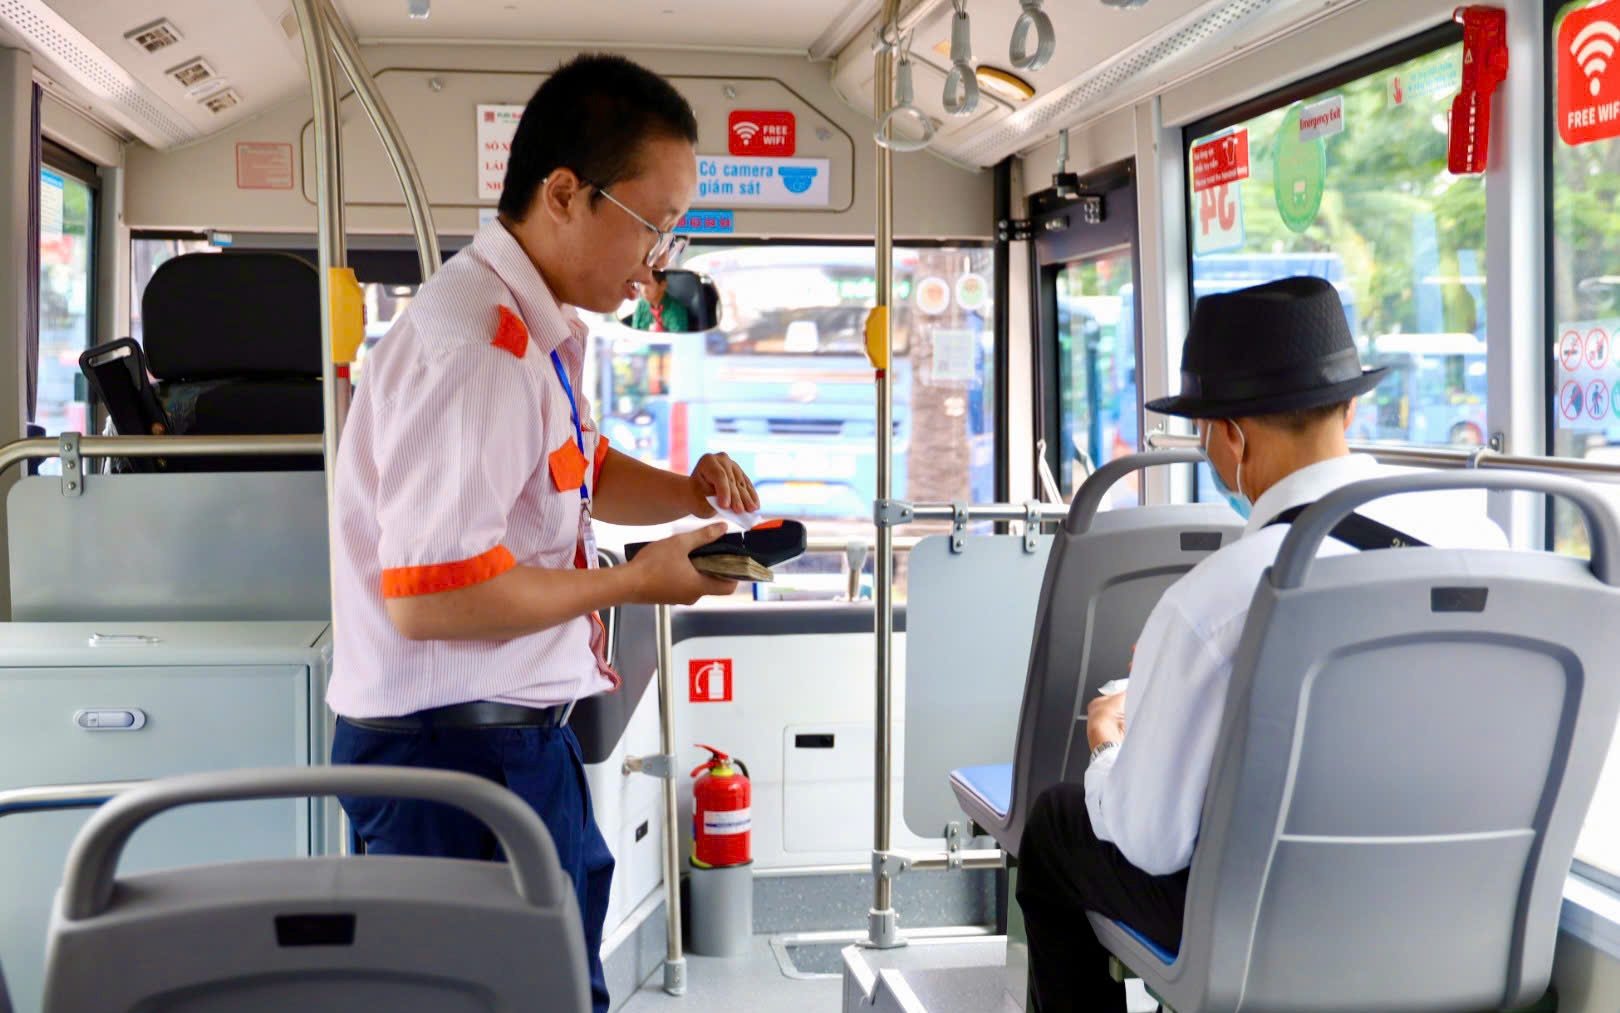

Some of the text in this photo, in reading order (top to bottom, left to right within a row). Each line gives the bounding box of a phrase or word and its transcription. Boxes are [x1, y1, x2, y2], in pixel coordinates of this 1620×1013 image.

[1299, 107, 1341, 130] Emergency Exit
[1568, 101, 1620, 129] FREE WIF
[763, 125, 788, 135] FREE
[763, 136, 785, 145] WIFI
[699, 161, 774, 177] Có camera
[486, 181, 504, 190] NH
[699, 180, 761, 196] giám sát
